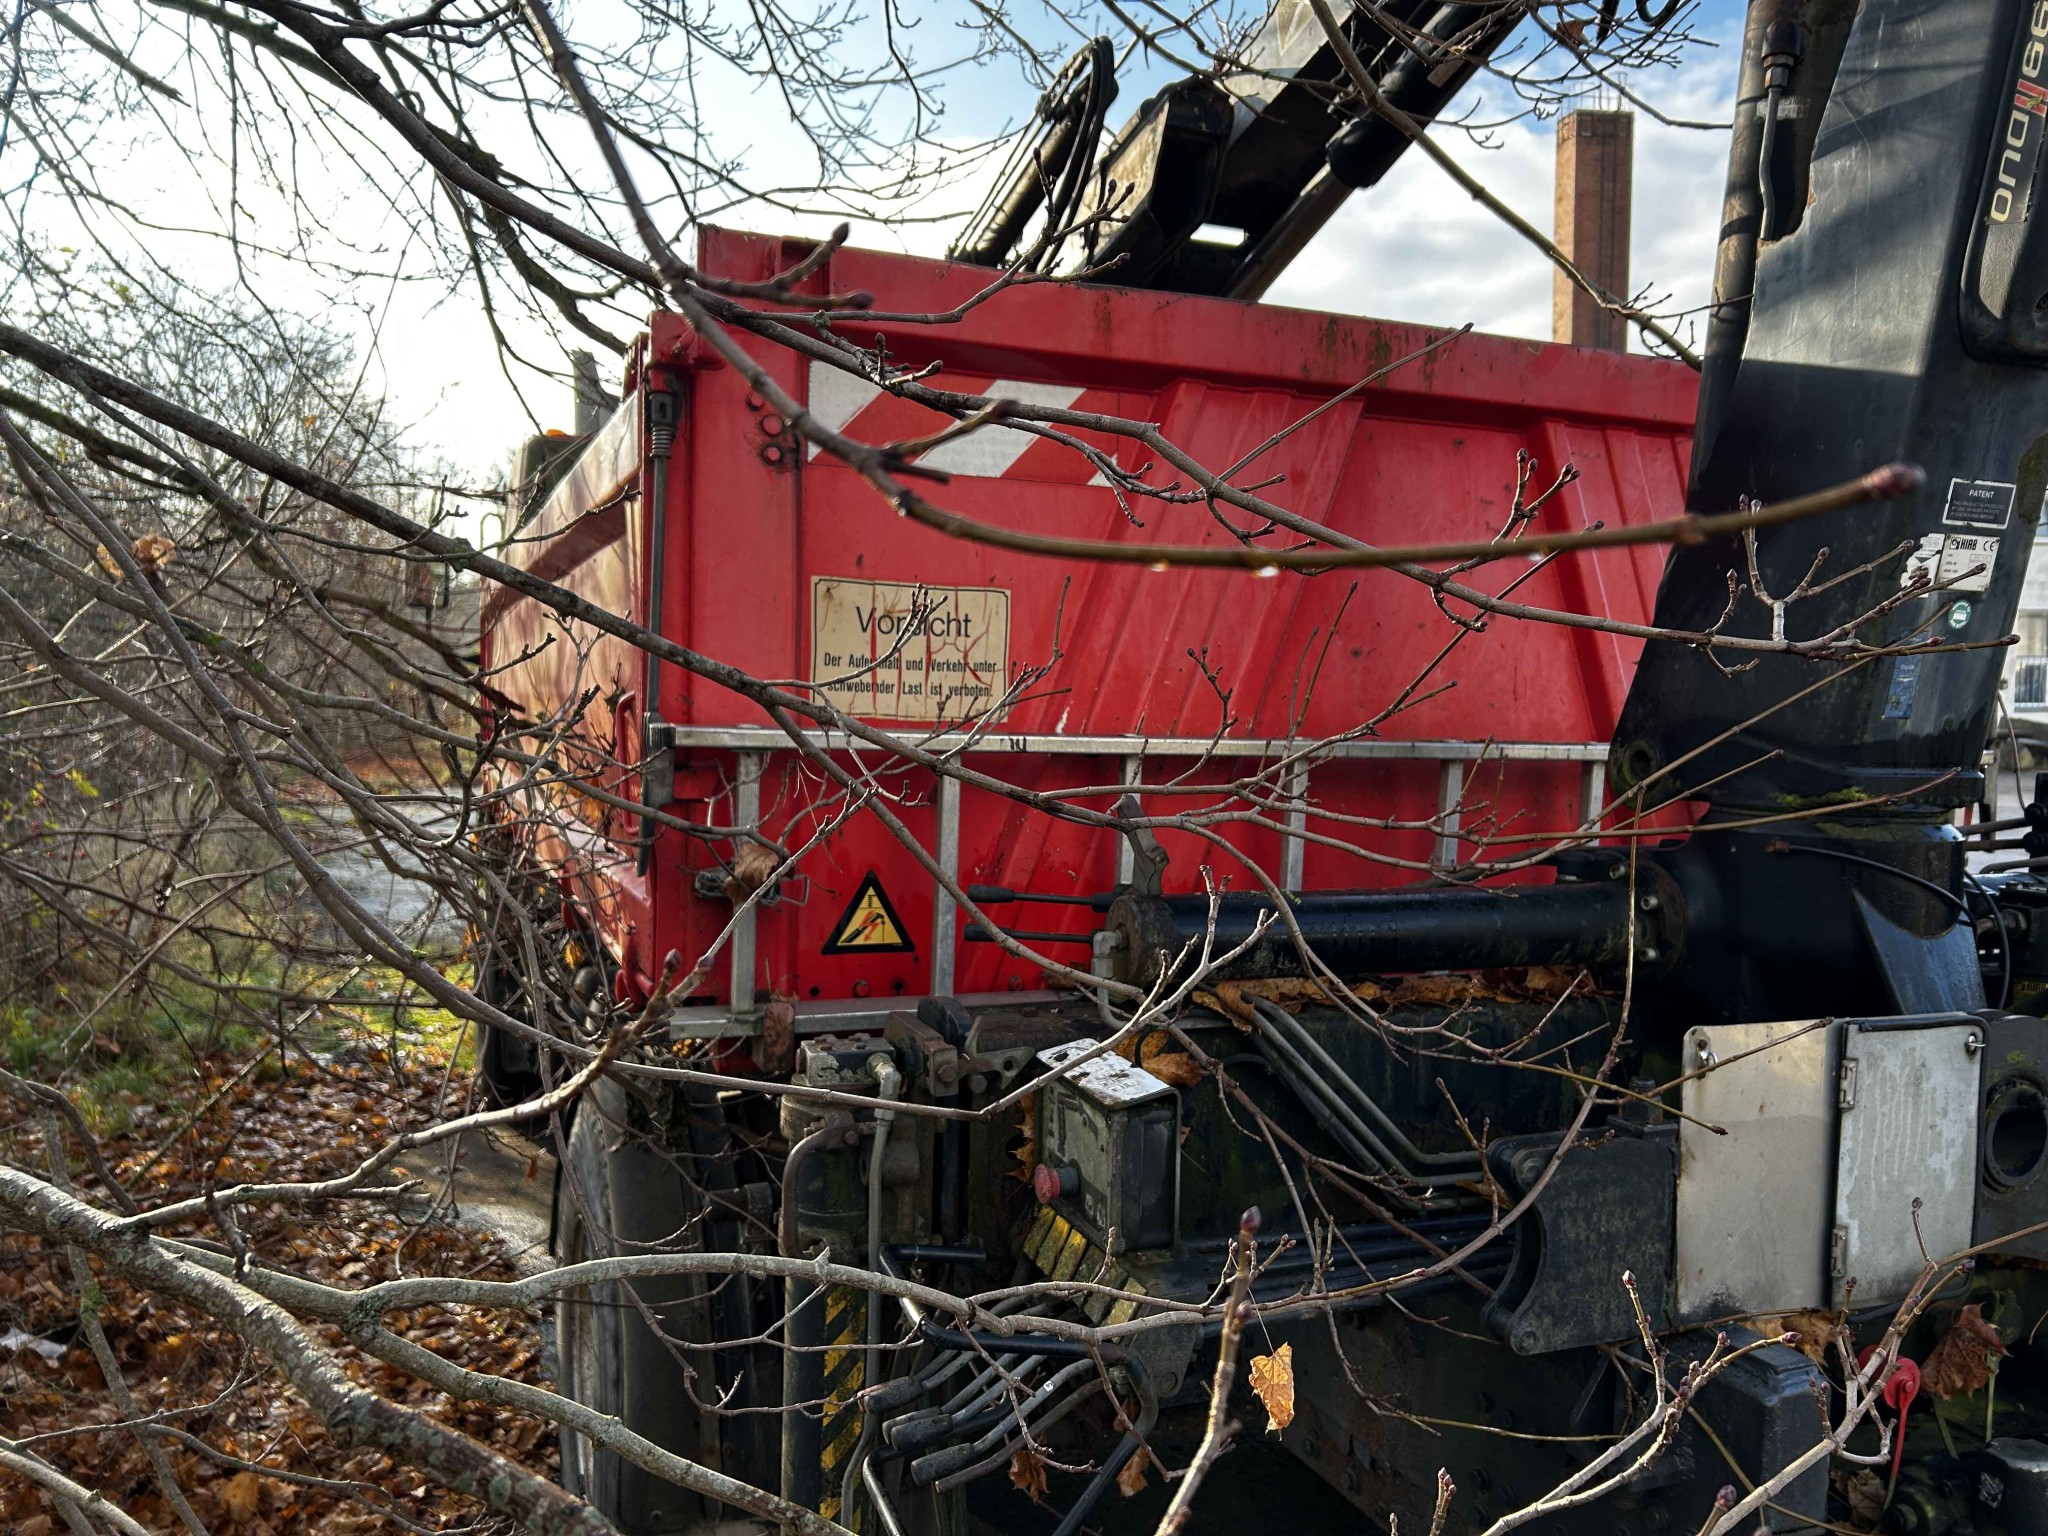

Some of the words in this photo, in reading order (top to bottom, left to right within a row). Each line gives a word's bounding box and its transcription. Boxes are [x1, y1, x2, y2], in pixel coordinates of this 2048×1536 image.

[1990, 110, 2029, 222] DUO
[1969, 489, 1995, 498] PATENT
[1959, 537, 1978, 550] HIAB
[824, 652, 842, 667] Der
[905, 657, 923, 671] und
[930, 658, 968, 673] Verkehr
[972, 659, 997, 673] unter
[901, 682, 922, 695] Last
[930, 683, 942, 696] ist
[948, 684, 993, 699] verboten.
